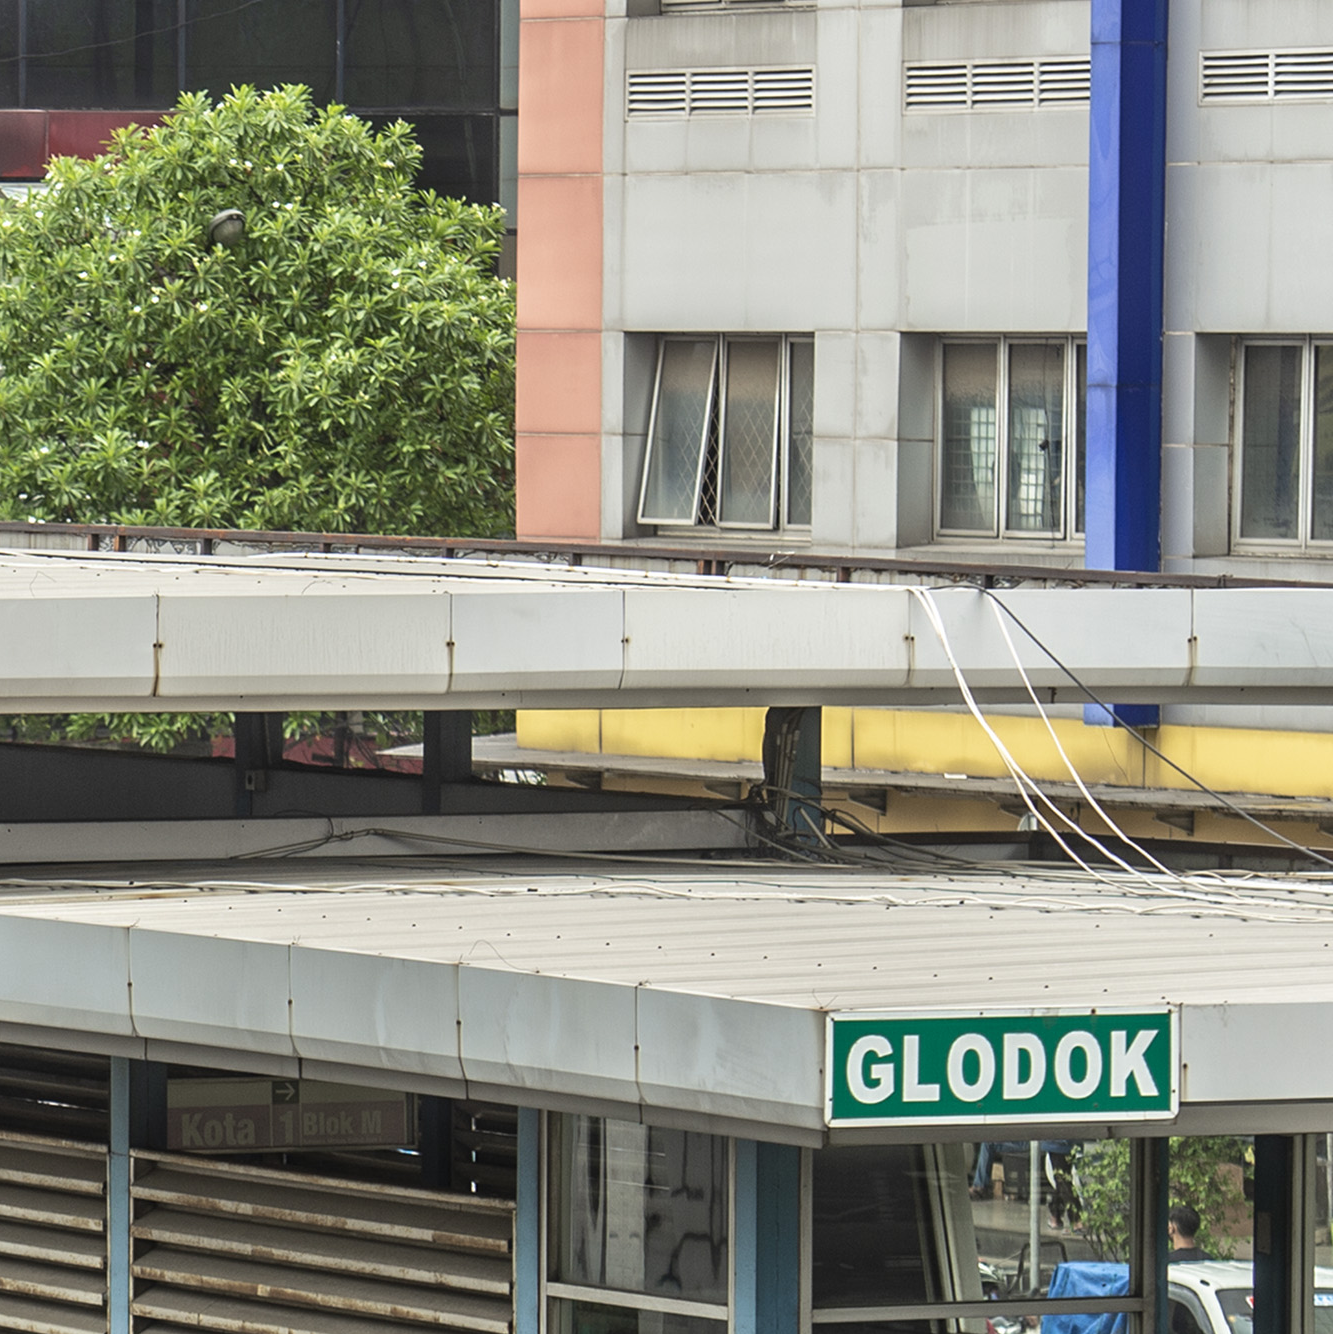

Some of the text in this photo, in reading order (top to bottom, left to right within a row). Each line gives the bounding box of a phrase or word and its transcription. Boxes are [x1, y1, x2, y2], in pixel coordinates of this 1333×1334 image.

[845, 1028, 1160, 1104] GLODOK
[181, 1110, 382, 1146] Kota 1 Blok M
